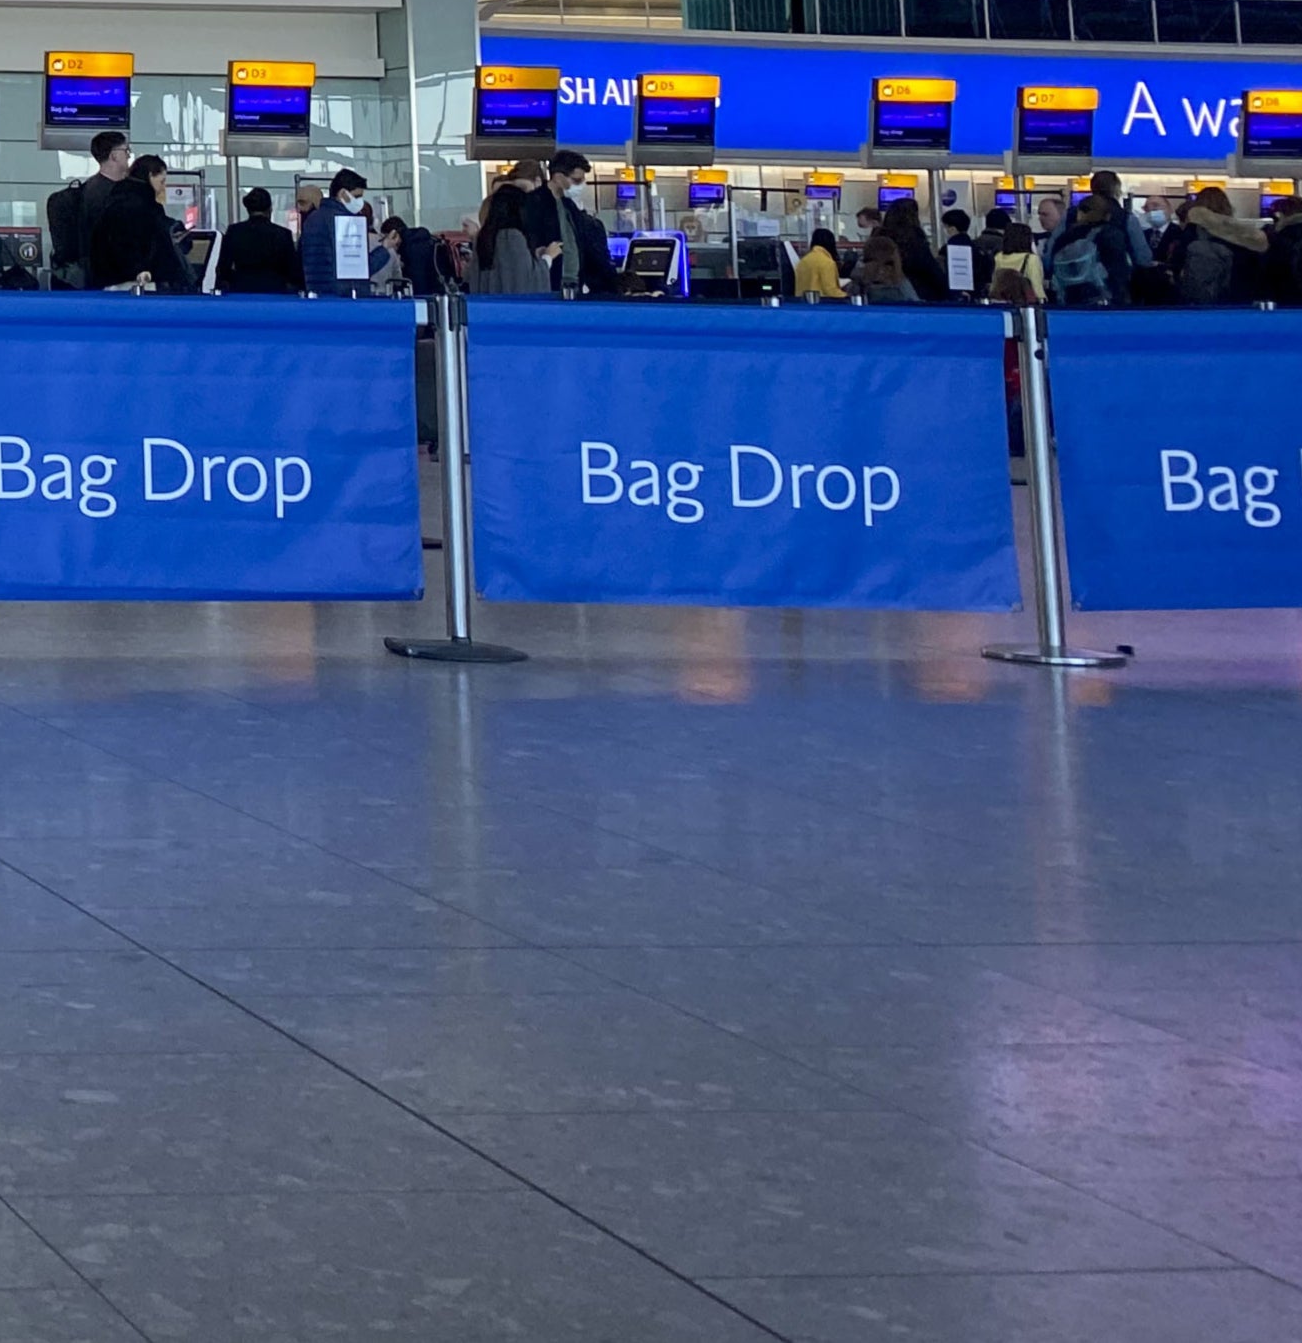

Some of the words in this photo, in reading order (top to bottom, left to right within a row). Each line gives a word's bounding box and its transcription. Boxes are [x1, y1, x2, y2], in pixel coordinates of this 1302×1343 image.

[68, 60, 84, 69] D2
[251, 69, 267, 78] D3
[499, 73, 514, 83] D4
[661, 82, 675, 91] D5
[1041, 94, 1055, 103] D7
[1122, 81, 1167, 136] A
[143, 437, 312, 519] Drop
[581, 441, 704, 524] Bag
[729, 444, 901, 527] Drop
[1160, 449, 1282, 528] Bag
